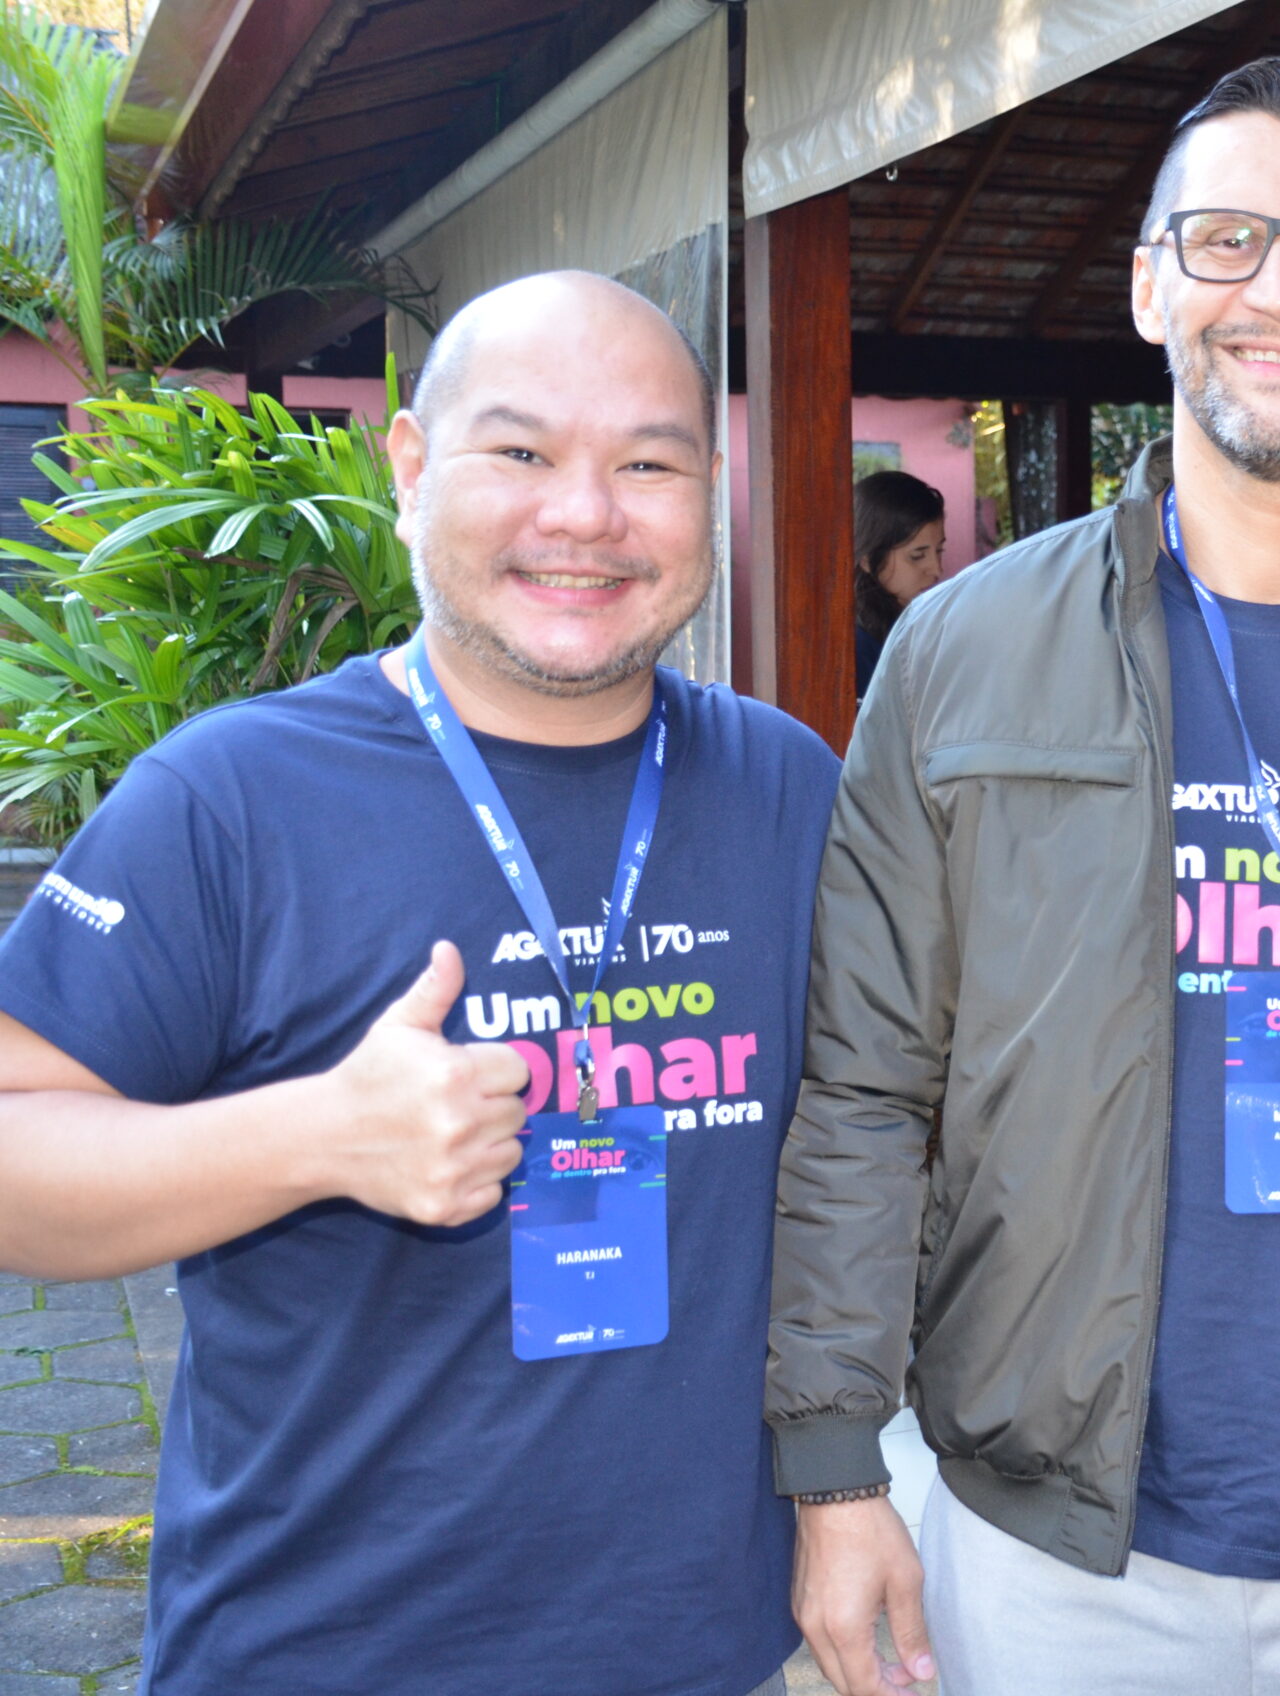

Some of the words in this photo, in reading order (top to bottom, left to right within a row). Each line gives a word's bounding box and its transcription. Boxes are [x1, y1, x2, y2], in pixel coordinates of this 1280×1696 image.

[651, 923, 695, 957] 70
[697, 929, 731, 944] anos
[464, 992, 562, 1039] Um
[575, 981, 715, 1025] novo
[664, 1107, 698, 1132] ra
[703, 1098, 763, 1128] fora
[551, 1138, 577, 1151] Um
[579, 1137, 615, 1149] novo
[550, 1148, 626, 1172] Olhar
[592, 1168, 607, 1178] pra
[608, 1166, 626, 1175] fora
[556, 1246, 623, 1266] HARANAKA
[602, 1327, 616, 1339] 70
